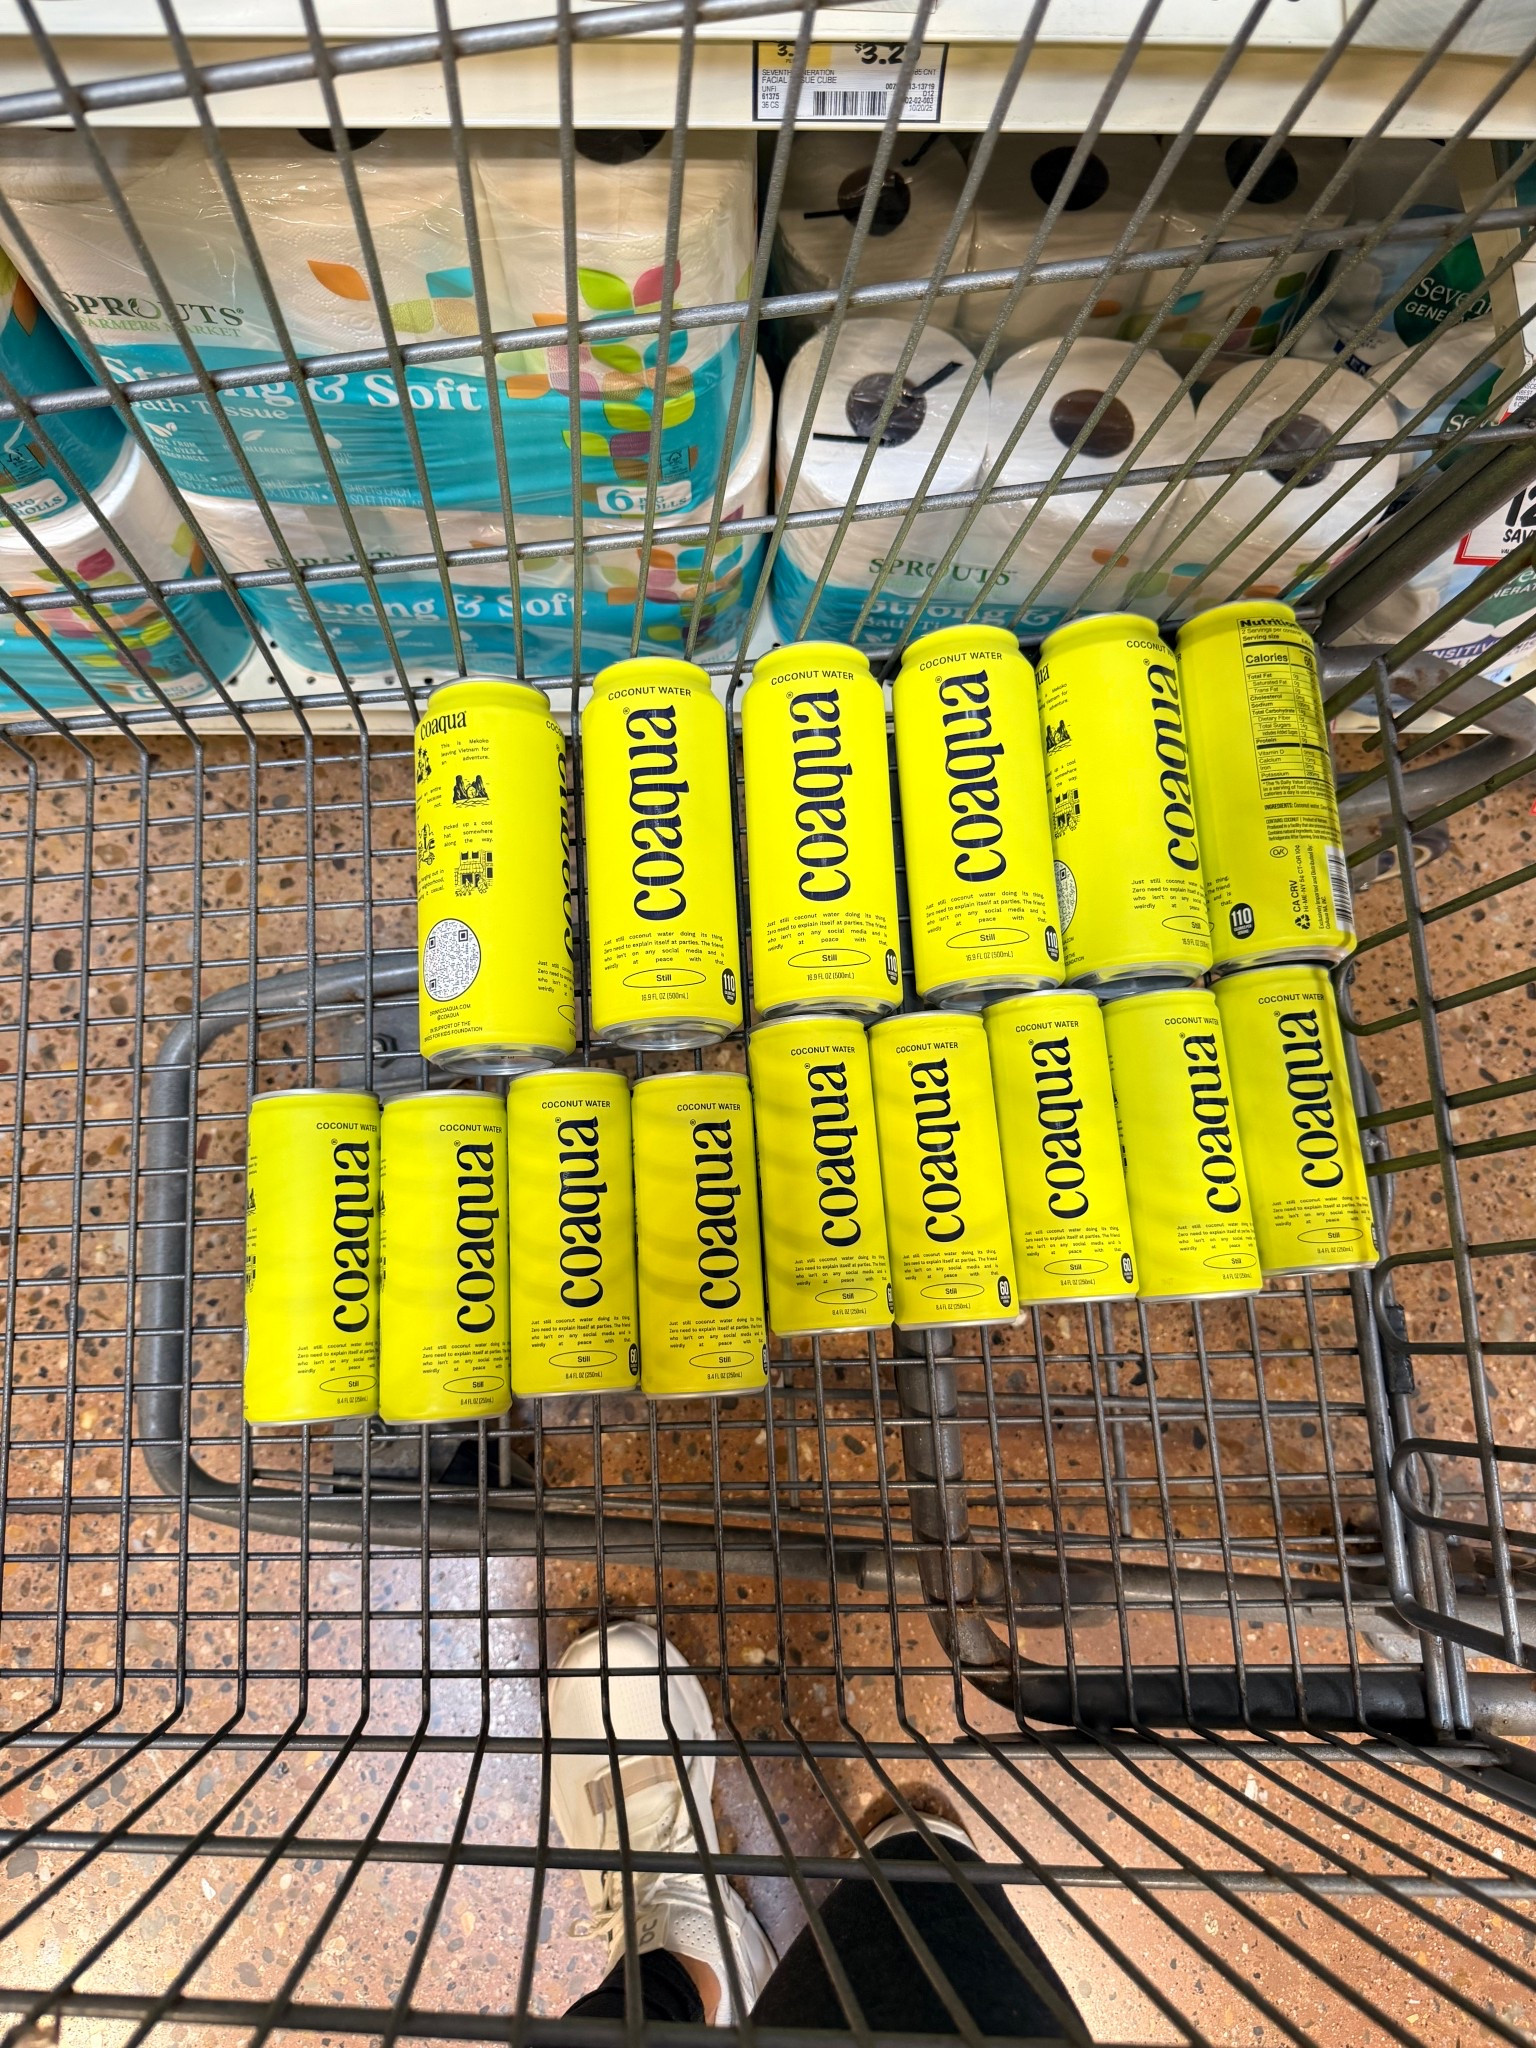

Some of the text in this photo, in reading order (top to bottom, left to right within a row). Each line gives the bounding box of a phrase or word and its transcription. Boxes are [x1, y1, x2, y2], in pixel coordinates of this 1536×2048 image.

[306, 373, 349, 404] &
[365, 373, 482, 411] Soft
[606, 489, 634, 511] 6
[1127, 638, 1166, 653] COCONUT
[920, 652, 1002, 671] COCONUT WATER
[1246, 653, 1288, 663] Calories
[771, 670, 853, 685] COCONUT WATER
[608, 687, 691, 700] COCONUT WATER
[1289, 880, 1301, 913] CA CRV
[1231, 908, 1252, 926] 110
[1258, 992, 1326, 1004] COCONUT WATER
[1165, 1017, 1202, 1025] COCONUT
[451, 1027, 483, 1035] FOUNDATION
[1016, 1022, 1052, 1032] COCONUT
[791, 1046, 830, 1056] COCONUT
[896, 1044, 931, 1054] COCONUT
[542, 1100, 583, 1109] COCONUT
[677, 1103, 716, 1111] COCONUT
[316, 1122, 378, 1133] COCONUT WATER
[483, 1124, 503, 1134] WATER
[999, 1280, 1009, 1296] 60
